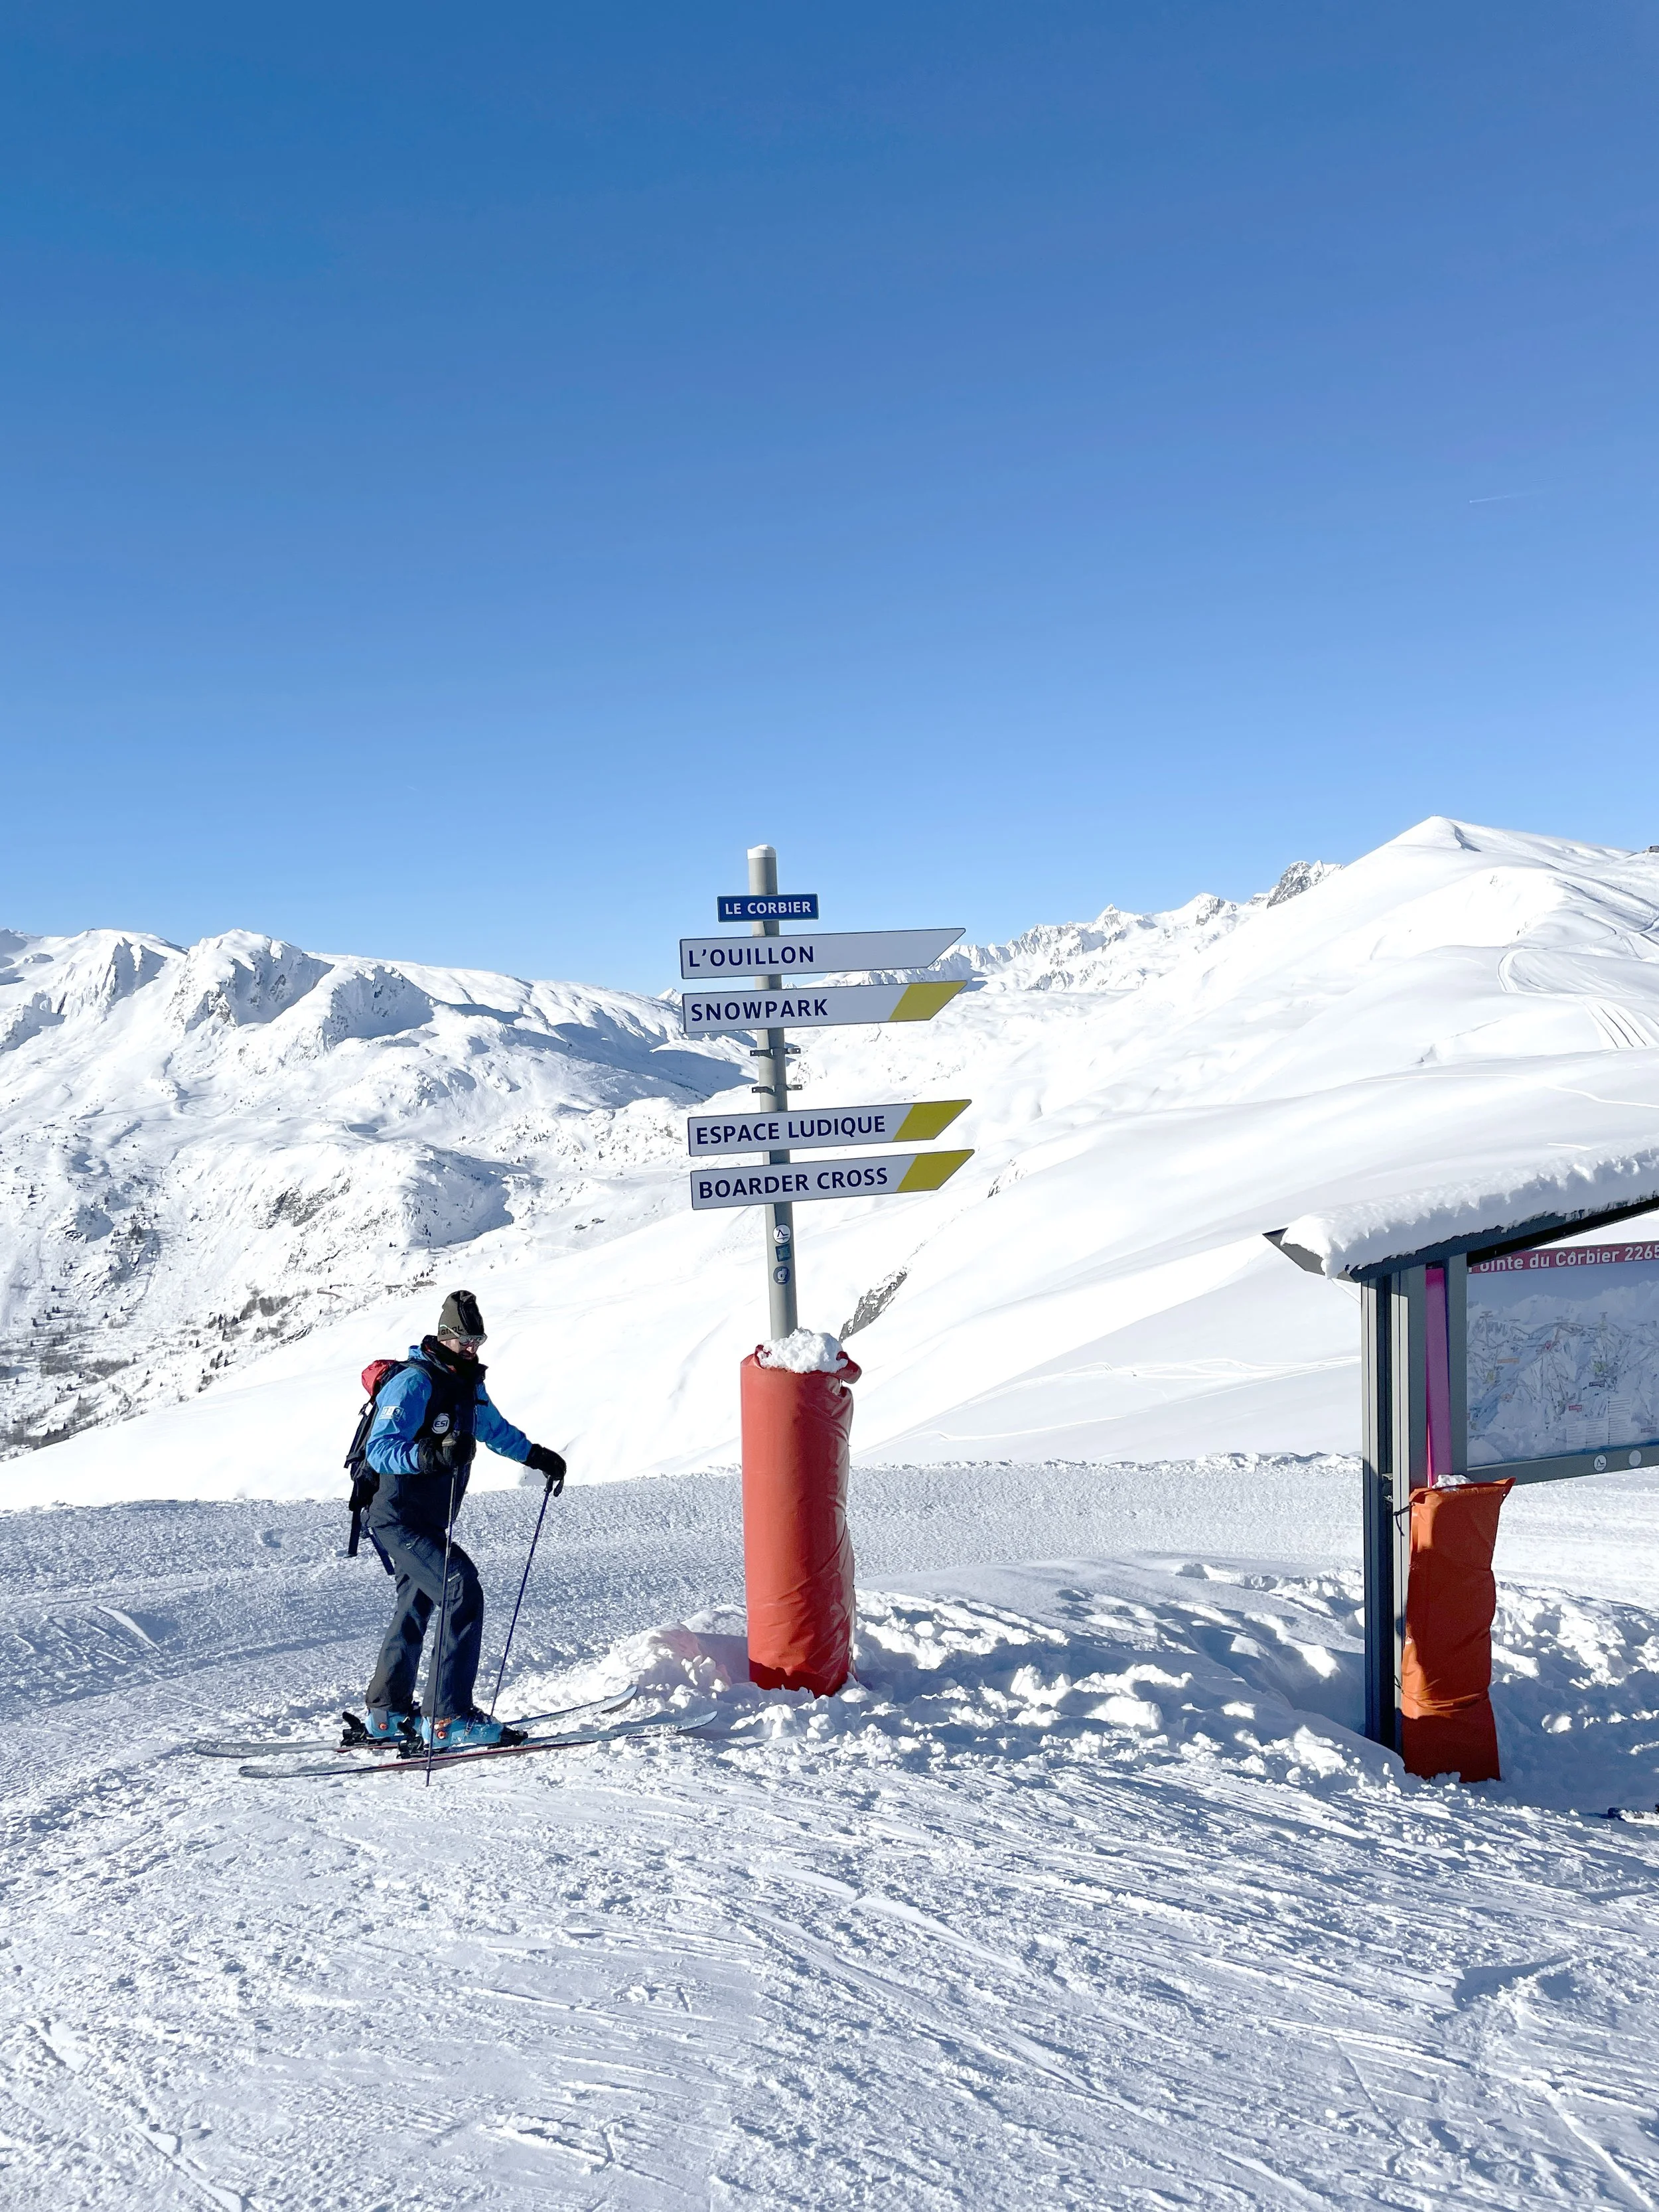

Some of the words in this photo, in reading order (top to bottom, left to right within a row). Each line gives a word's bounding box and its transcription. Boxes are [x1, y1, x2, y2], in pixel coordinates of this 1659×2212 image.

[725, 902, 742, 915] LE
[747, 901, 812, 915] CORBIER
[691, 998, 829, 1022] SNOWPARK
[696, 1122, 780, 1145] ESPACE
[788, 1115, 887, 1139] LUDIQUE
[699, 1174, 810, 1200] BOARDER
[817, 1167, 889, 1191] CROSS
[1529, 1253, 1550, 1268] du
